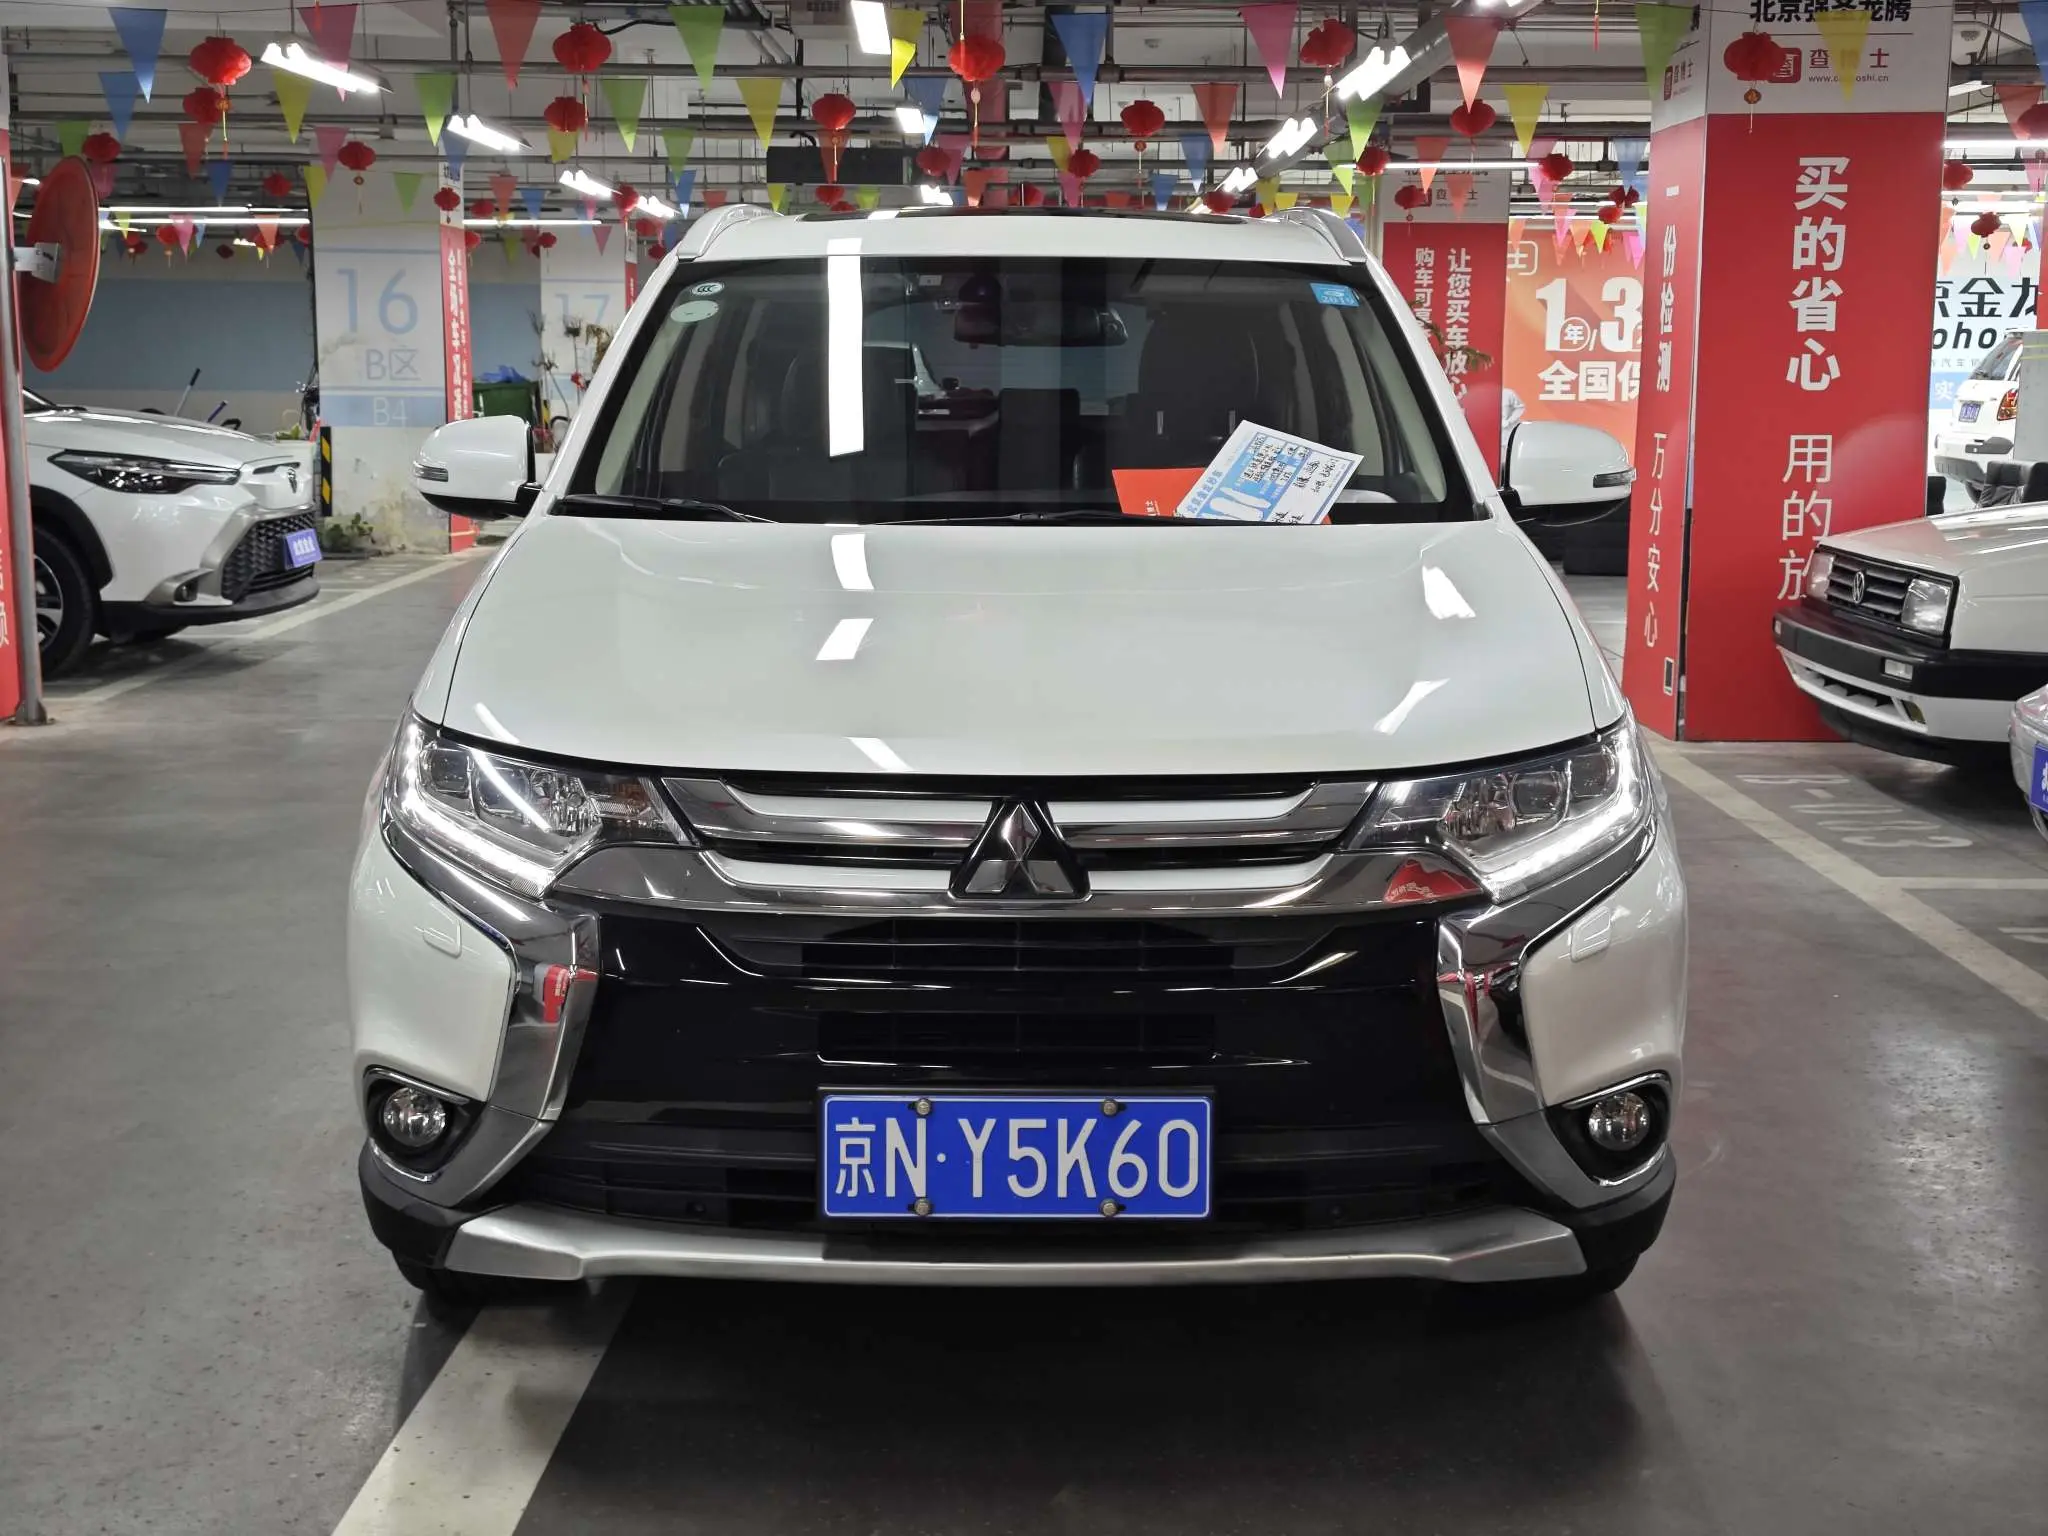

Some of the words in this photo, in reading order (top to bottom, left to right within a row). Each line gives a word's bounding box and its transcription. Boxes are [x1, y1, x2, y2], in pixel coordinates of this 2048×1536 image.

[1809, 48, 1889, 69] 查士
[1786, 156, 1851, 392] 买的省心
[337, 268, 419, 335] 16
[366, 347, 421, 381] B区
[373, 396, 408, 426] B4
[1644, 432, 1667, 648] 万分安心
